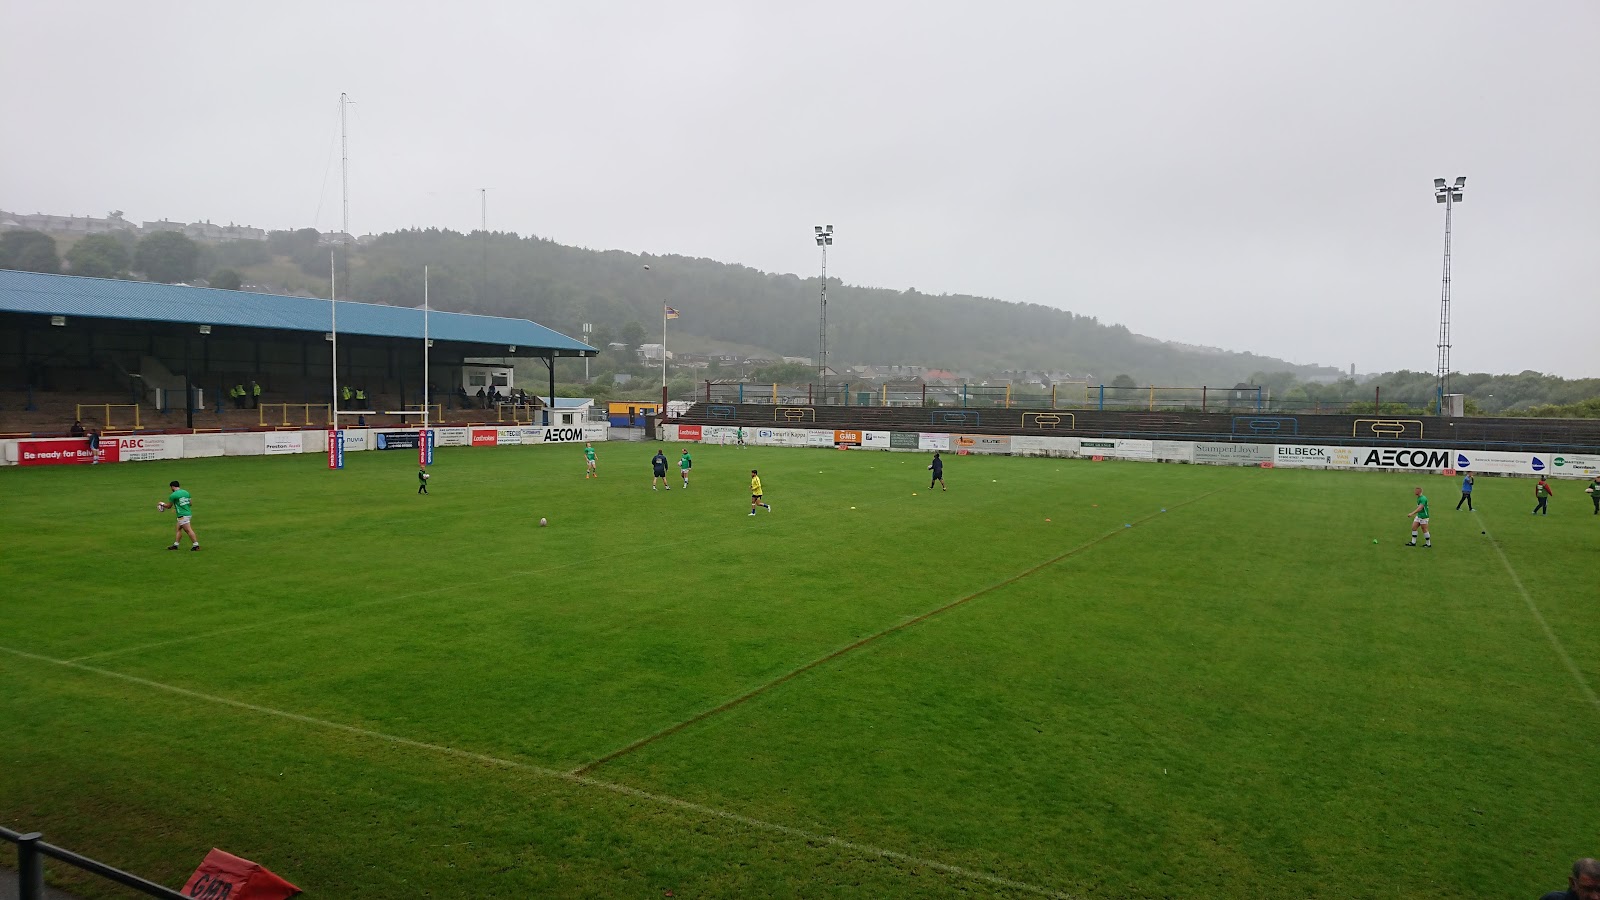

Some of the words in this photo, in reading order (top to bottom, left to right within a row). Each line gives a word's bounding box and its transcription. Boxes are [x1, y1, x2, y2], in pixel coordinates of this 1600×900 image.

[544, 428, 582, 441] AECOM
[120, 439, 144, 449] ABC
[37, 451, 60, 460] ready
[77, 449, 105, 457] Belvr!
[1278, 447, 1325, 456] EILBECK
[1364, 449, 1449, 468] AECOM
